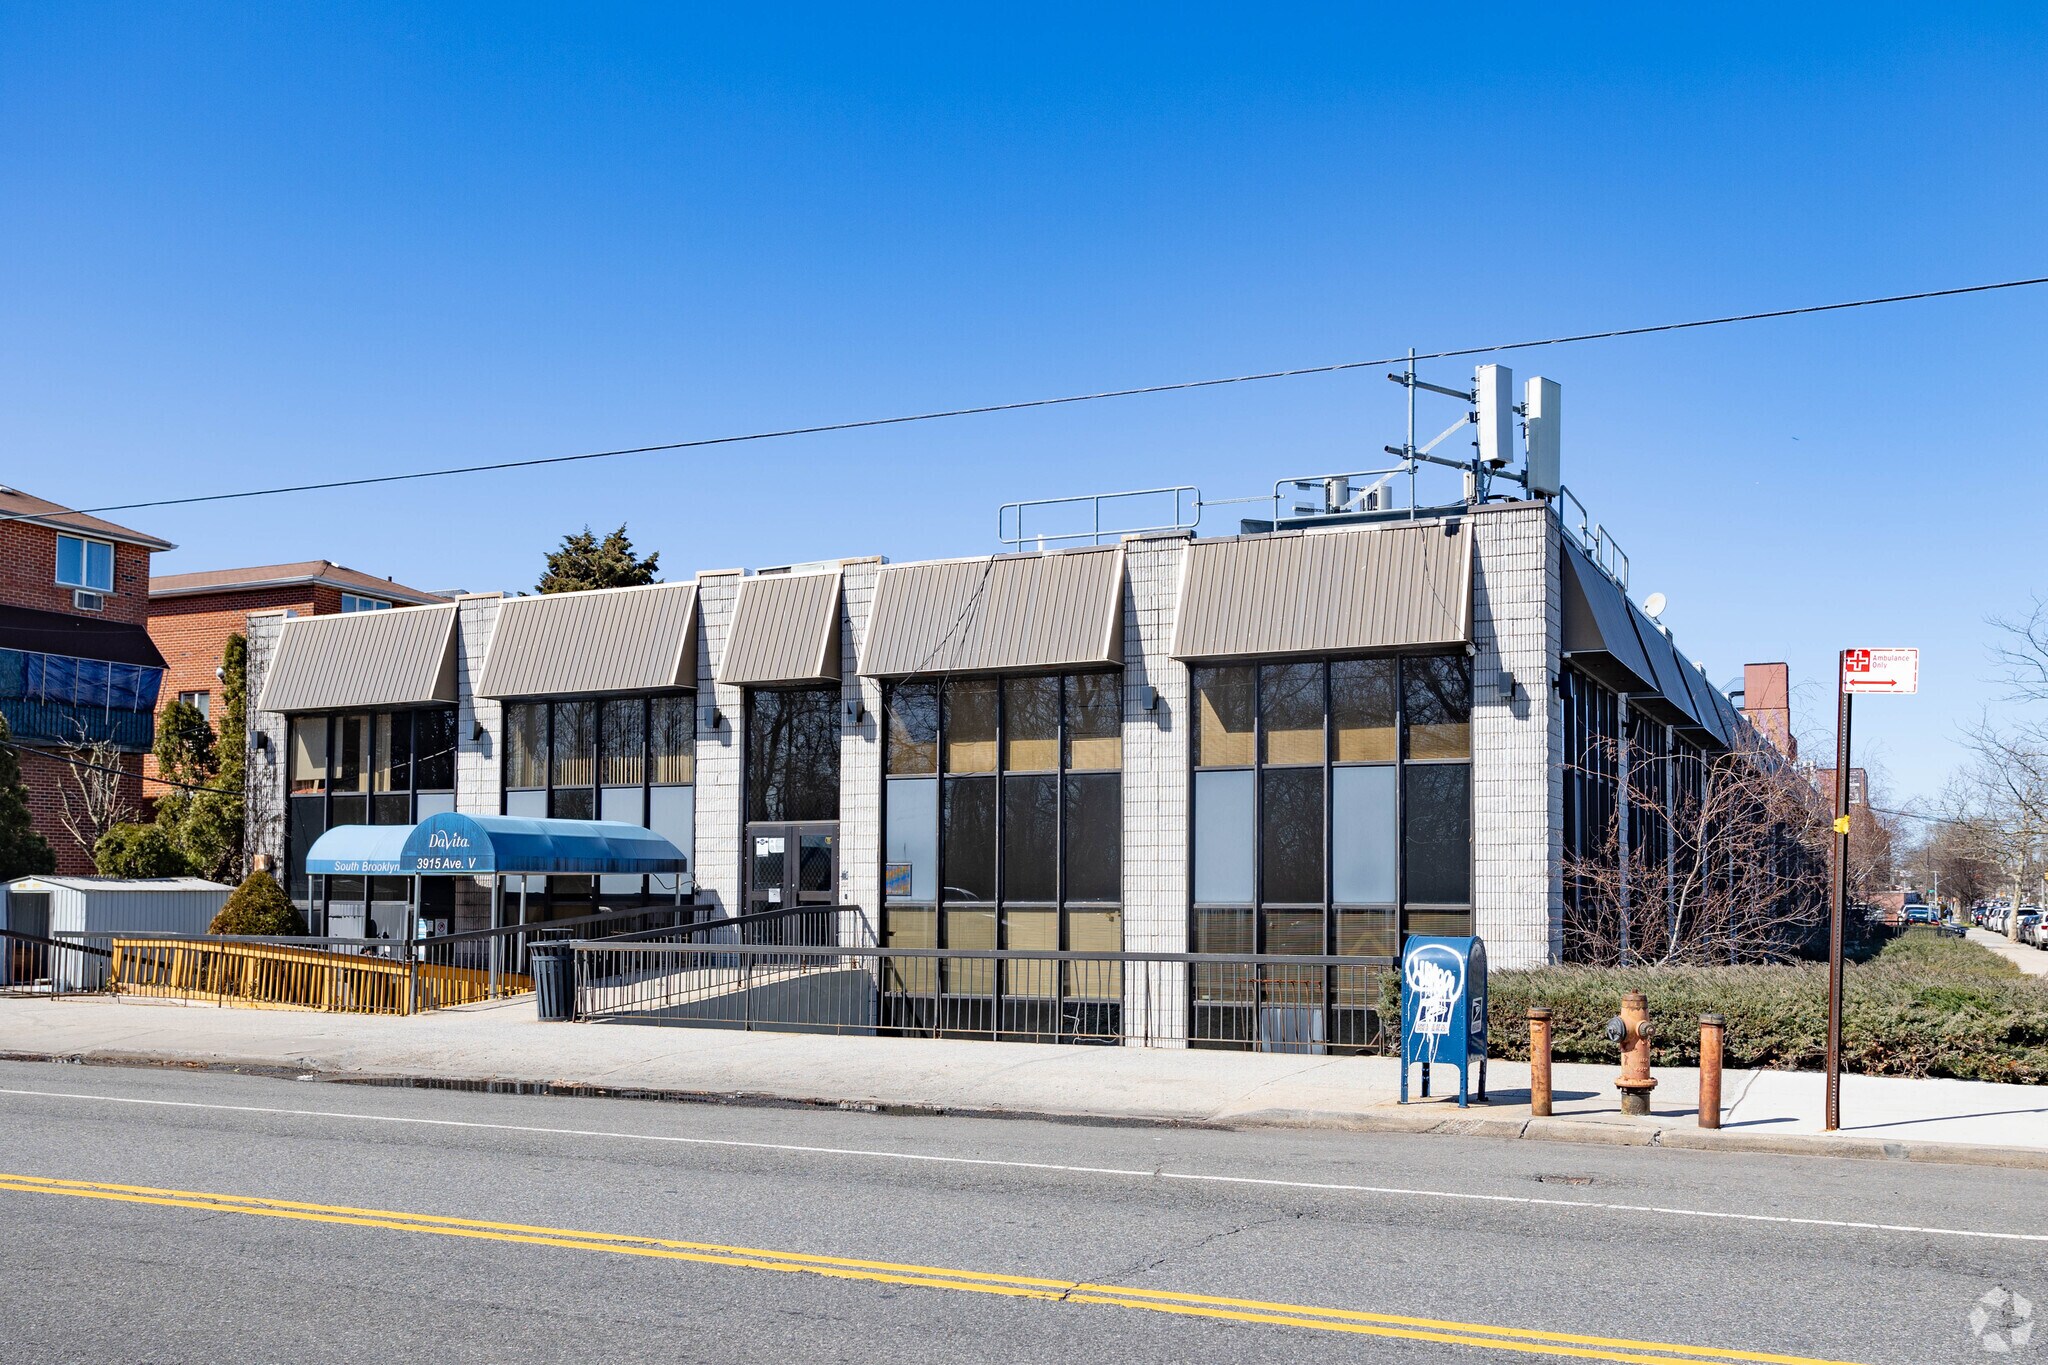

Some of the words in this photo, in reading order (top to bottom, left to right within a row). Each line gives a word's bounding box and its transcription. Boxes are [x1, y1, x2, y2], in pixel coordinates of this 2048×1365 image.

[334, 861, 360, 872] South
[361, 861, 400, 874] Brooklyn
[416, 857, 441, 869] 3915
[442, 857, 464, 869] Ave.
[468, 857, 477, 869] V
